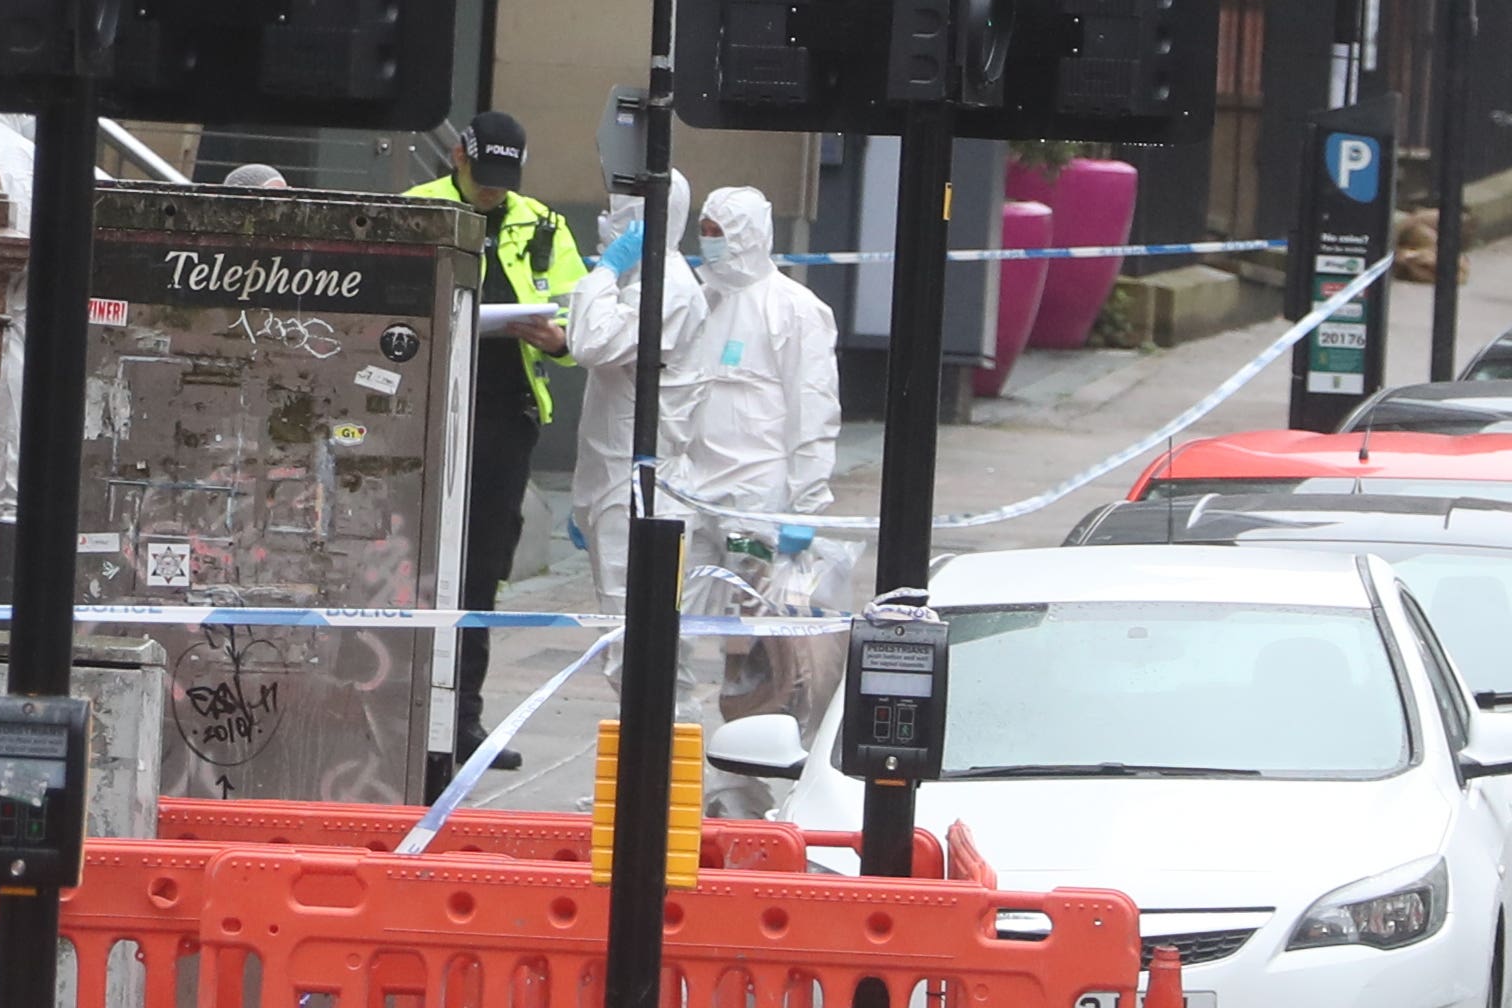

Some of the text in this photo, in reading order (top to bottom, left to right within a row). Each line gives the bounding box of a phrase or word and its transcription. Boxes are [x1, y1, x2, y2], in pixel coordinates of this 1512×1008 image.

[485, 143, 521, 160] POLICE
[1338, 139, 1373, 190] P
[164, 250, 363, 301] Telephone
[1320, 332, 1366, 346] 20176
[341, 427, 356, 439] G1
